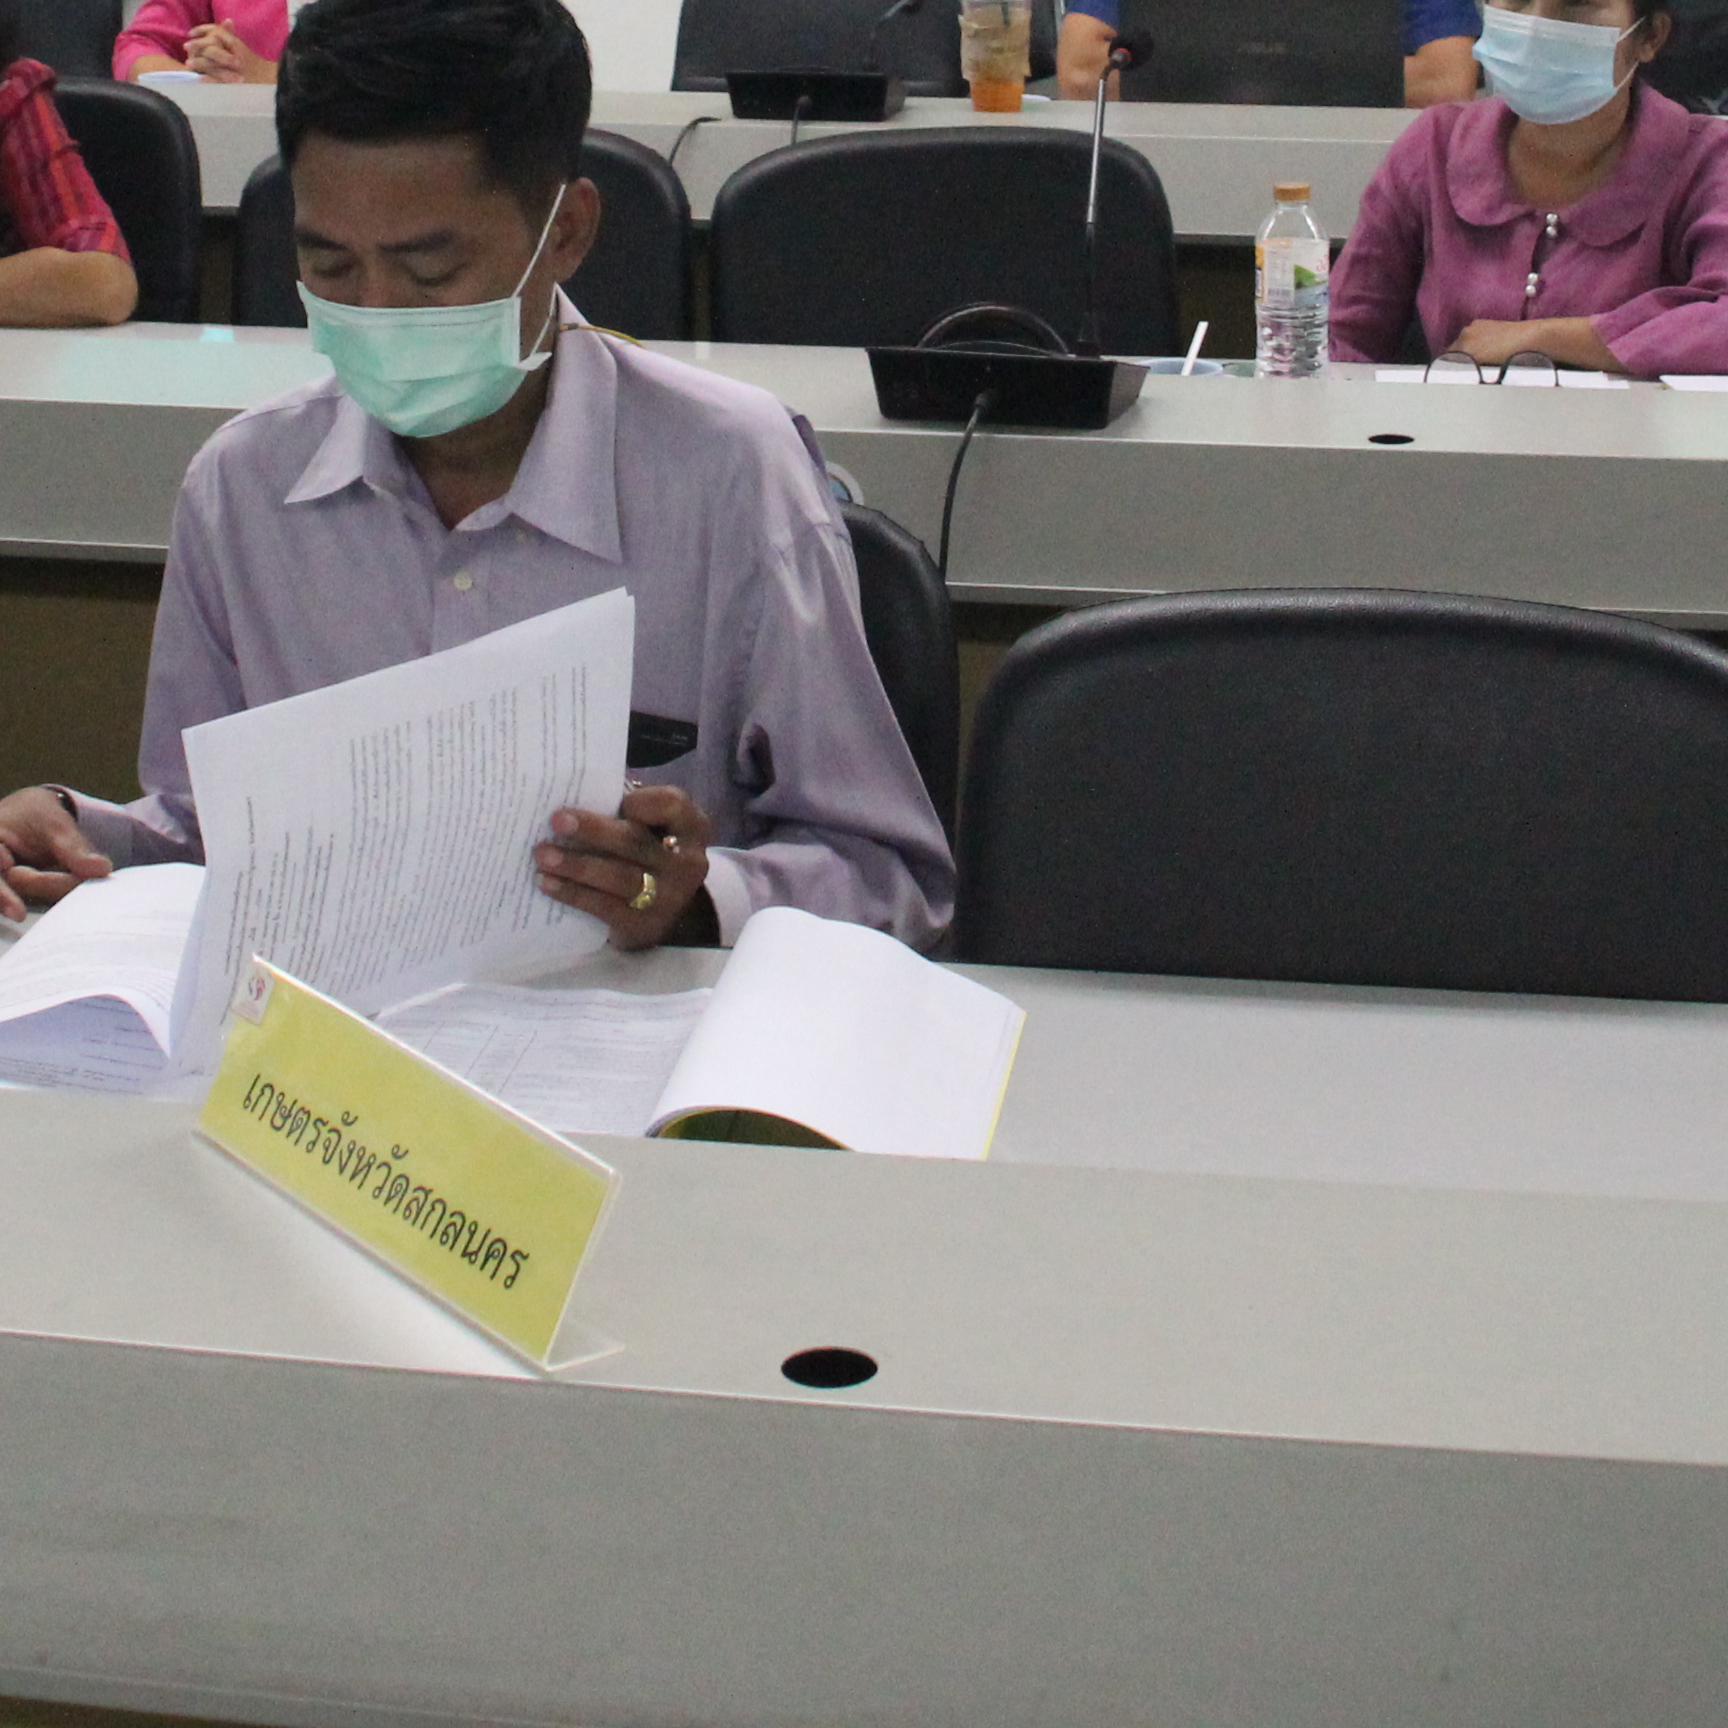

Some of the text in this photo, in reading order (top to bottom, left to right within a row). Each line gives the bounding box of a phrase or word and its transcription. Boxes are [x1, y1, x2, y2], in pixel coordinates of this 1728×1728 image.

[243, 1073, 529, 1289] เกษตรจังหวัดสกลนคร
